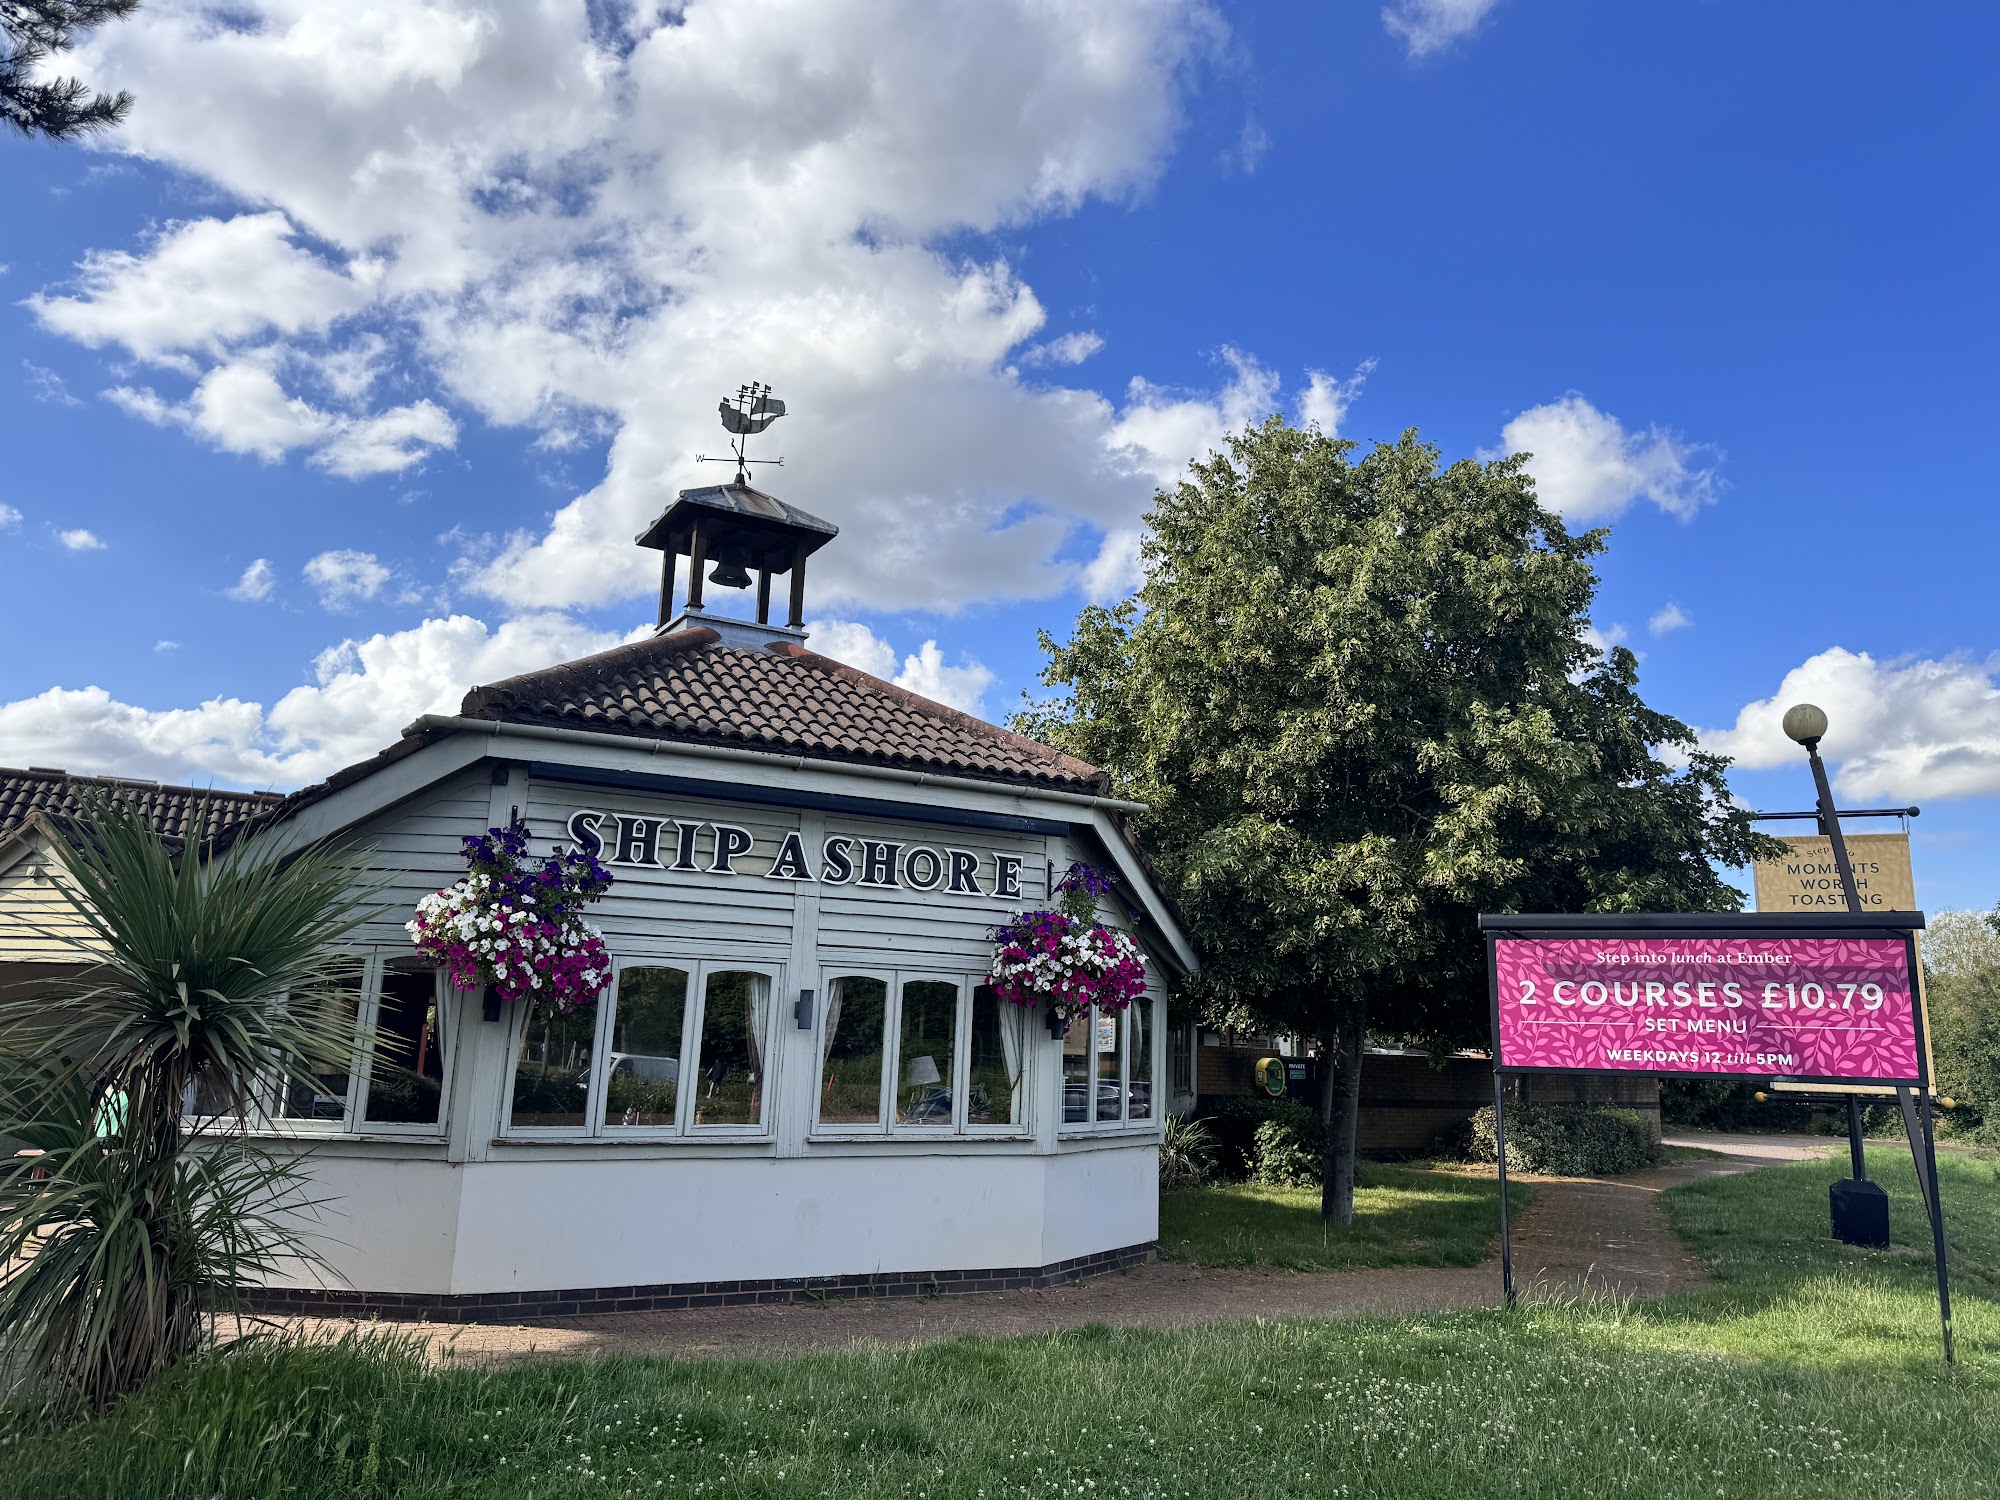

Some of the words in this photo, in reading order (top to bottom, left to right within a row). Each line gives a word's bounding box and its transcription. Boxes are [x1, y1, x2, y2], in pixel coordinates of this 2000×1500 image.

[565, 809, 753, 876] SHIP
[1806, 846, 1830, 858] Step
[1800, 878, 1868, 890] WORH
[1788, 893, 1883, 906] TOASTNG
[1597, 952, 1630, 966] Step
[1634, 952, 1667, 964] into
[1671, 952, 1713, 964] lunch
[1717, 953, 1733, 964] at
[1737, 952, 1793, 965] Ember
[1518, 980, 1537, 1005] 2
[1552, 980, 1744, 1009] COURSES
[1761, 982, 1885, 1011] £10.79
[1644, 1018, 1680, 1032] SET
[1687, 1019, 1747, 1034] MENU
[1607, 1049, 1699, 1063] WEEKDAYS
[1705, 1052, 1721, 1064] 12
[1726, 1053, 1751, 1065] till
[1756, 1053, 1793, 1066] 5PM
